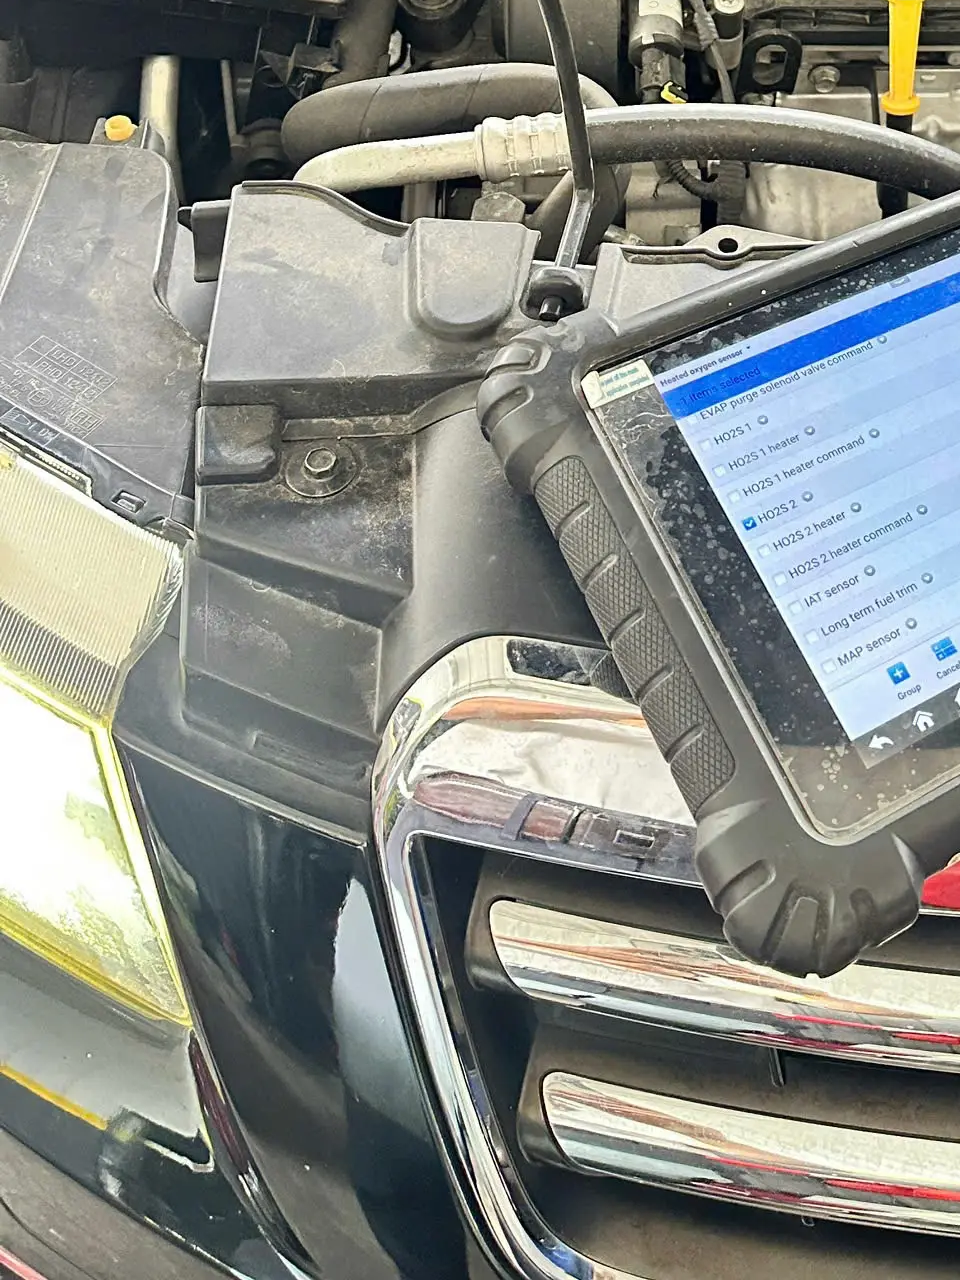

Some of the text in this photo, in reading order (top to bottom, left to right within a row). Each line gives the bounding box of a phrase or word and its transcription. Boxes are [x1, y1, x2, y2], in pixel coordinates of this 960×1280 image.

[660, 370, 689, 388] Heated
[689, 359, 718, 376] oxygen
[718, 350, 744, 365] sensor
[700, 341, 874, 421] EVAP purge solenoid valve command
[719, 366, 761, 389] selected
[713, 427, 744, 446] HO2S
[728, 452, 759, 471] HO2S
[769, 433, 801, 454] heater
[742, 477, 774, 497] HO2S
[783, 458, 815, 480] heater
[816, 435, 865, 465] command
[757, 499, 798, 524] HO2S 2
[772, 511, 846, 552] HO2S 2 heater
[788, 512, 914, 579] HO2S 2 heater command
[804, 575, 860, 608] IAT sensor
[820, 582, 919, 637] Long term fuel trim
[836, 628, 901, 667] MAP sensor
[897, 683, 922, 701] Group
